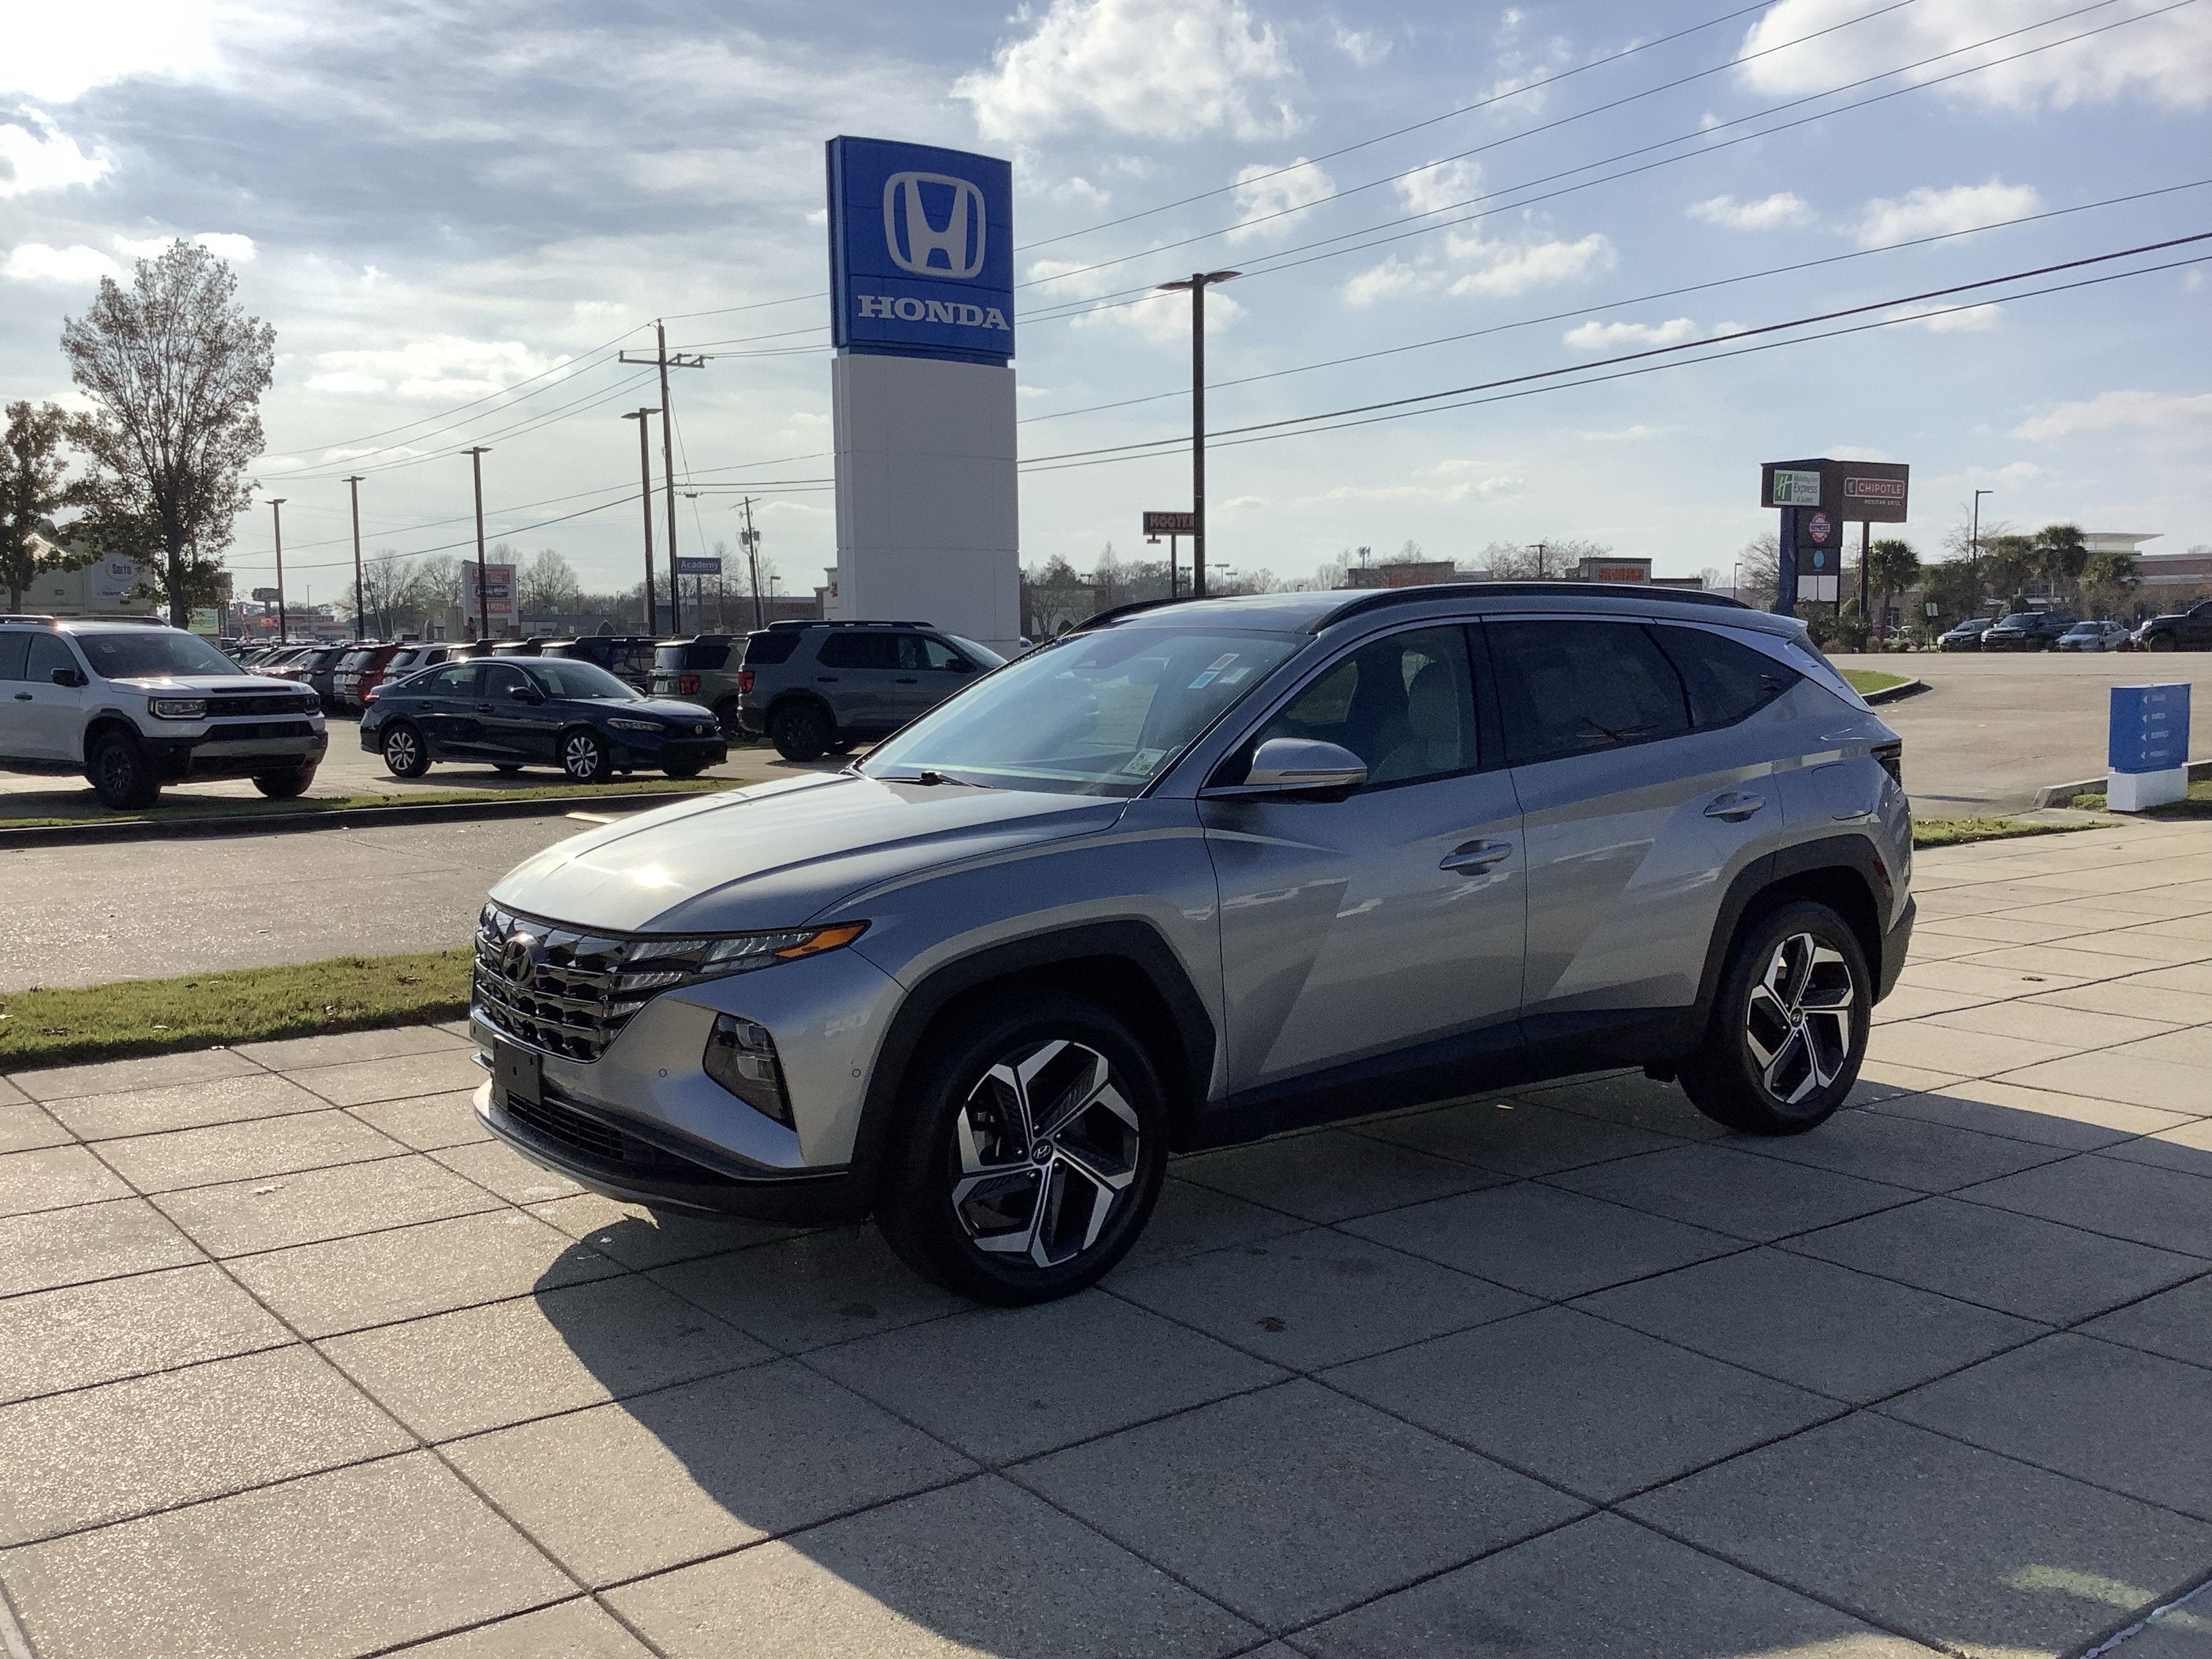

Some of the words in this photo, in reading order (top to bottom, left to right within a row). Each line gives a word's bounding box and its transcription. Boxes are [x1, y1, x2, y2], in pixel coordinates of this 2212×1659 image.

[857, 295, 1010, 331] HONDA
[1793, 482, 1818, 495] Express
[1859, 483, 1902, 494] CHIPOTLE
[680, 560, 718, 571] Academy
